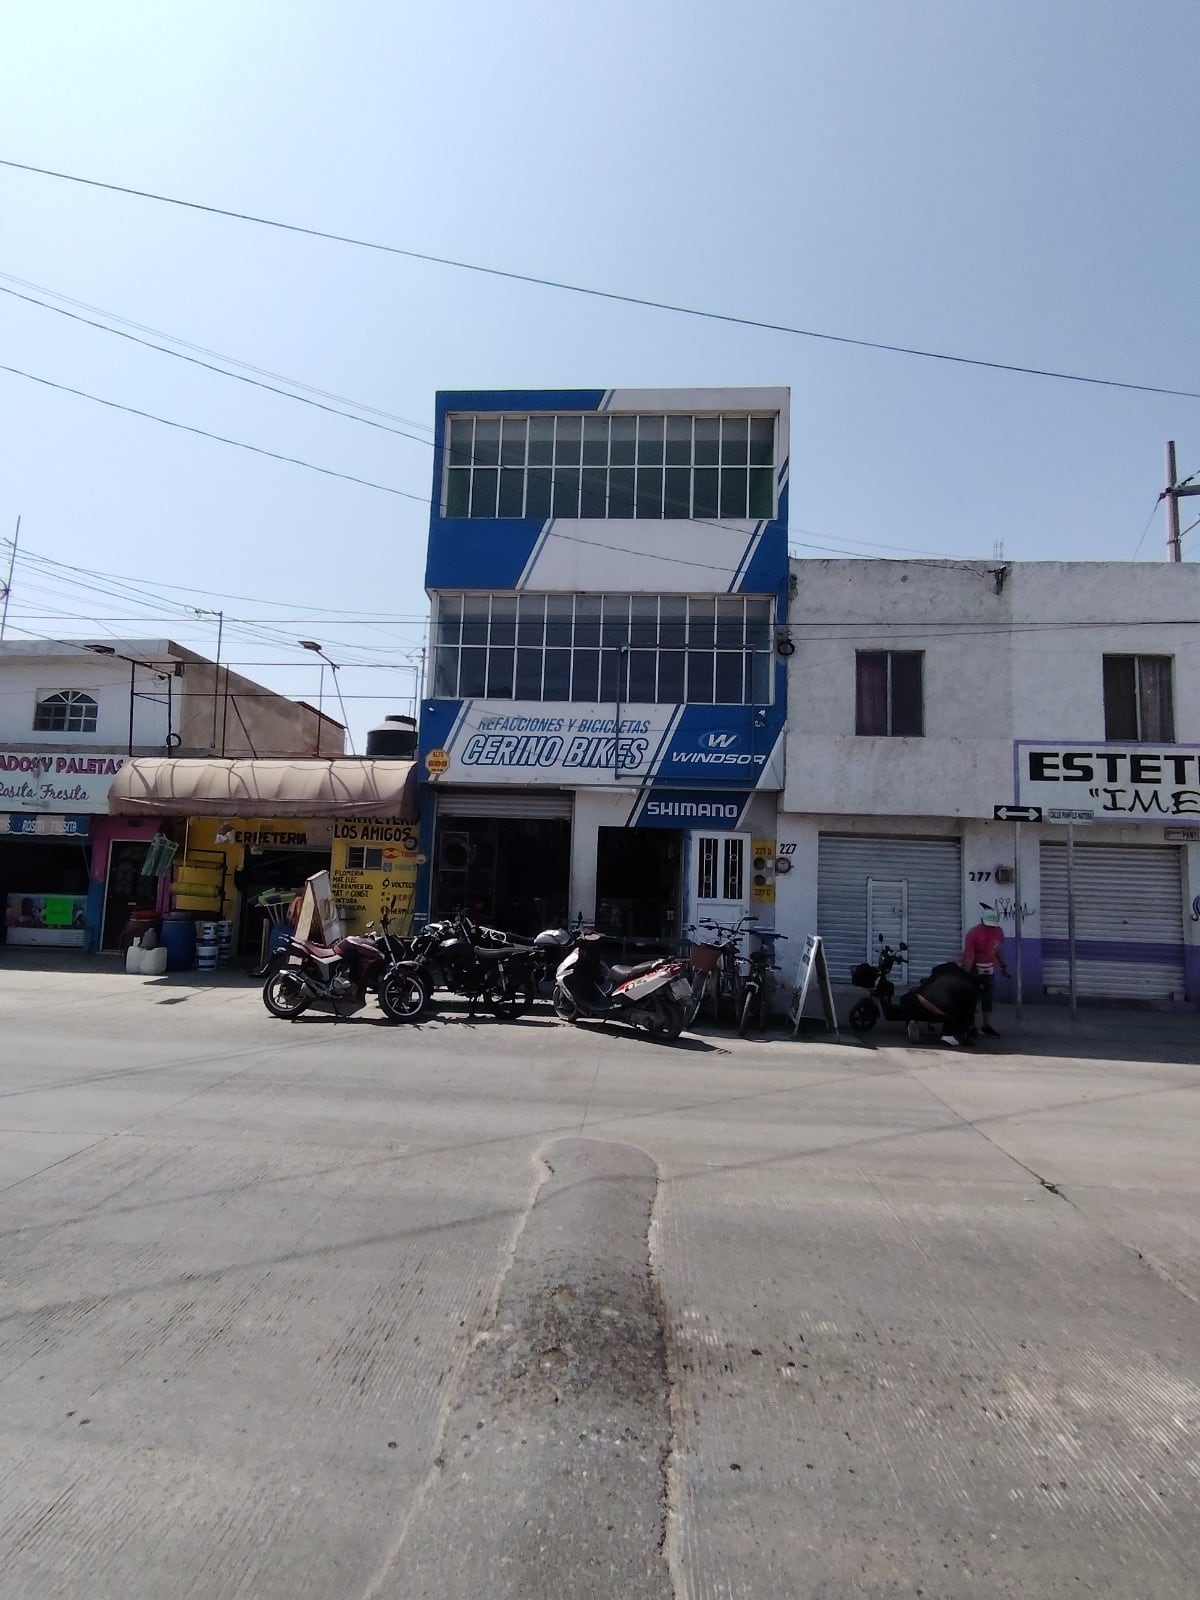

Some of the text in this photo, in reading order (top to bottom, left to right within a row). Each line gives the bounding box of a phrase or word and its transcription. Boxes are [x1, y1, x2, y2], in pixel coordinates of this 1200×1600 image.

[478, 717, 651, 733] REFACCIONES Y BICICLETAS
[461, 734, 650, 769] CERINO BIKES
[647, 801, 738, 818] SHIMANO
[235, 831, 307, 845] ERRETERIA
[334, 824, 412, 842] LOS AMIGOS
[780, 843, 797, 855] 227
[968, 871, 991, 882] 277
